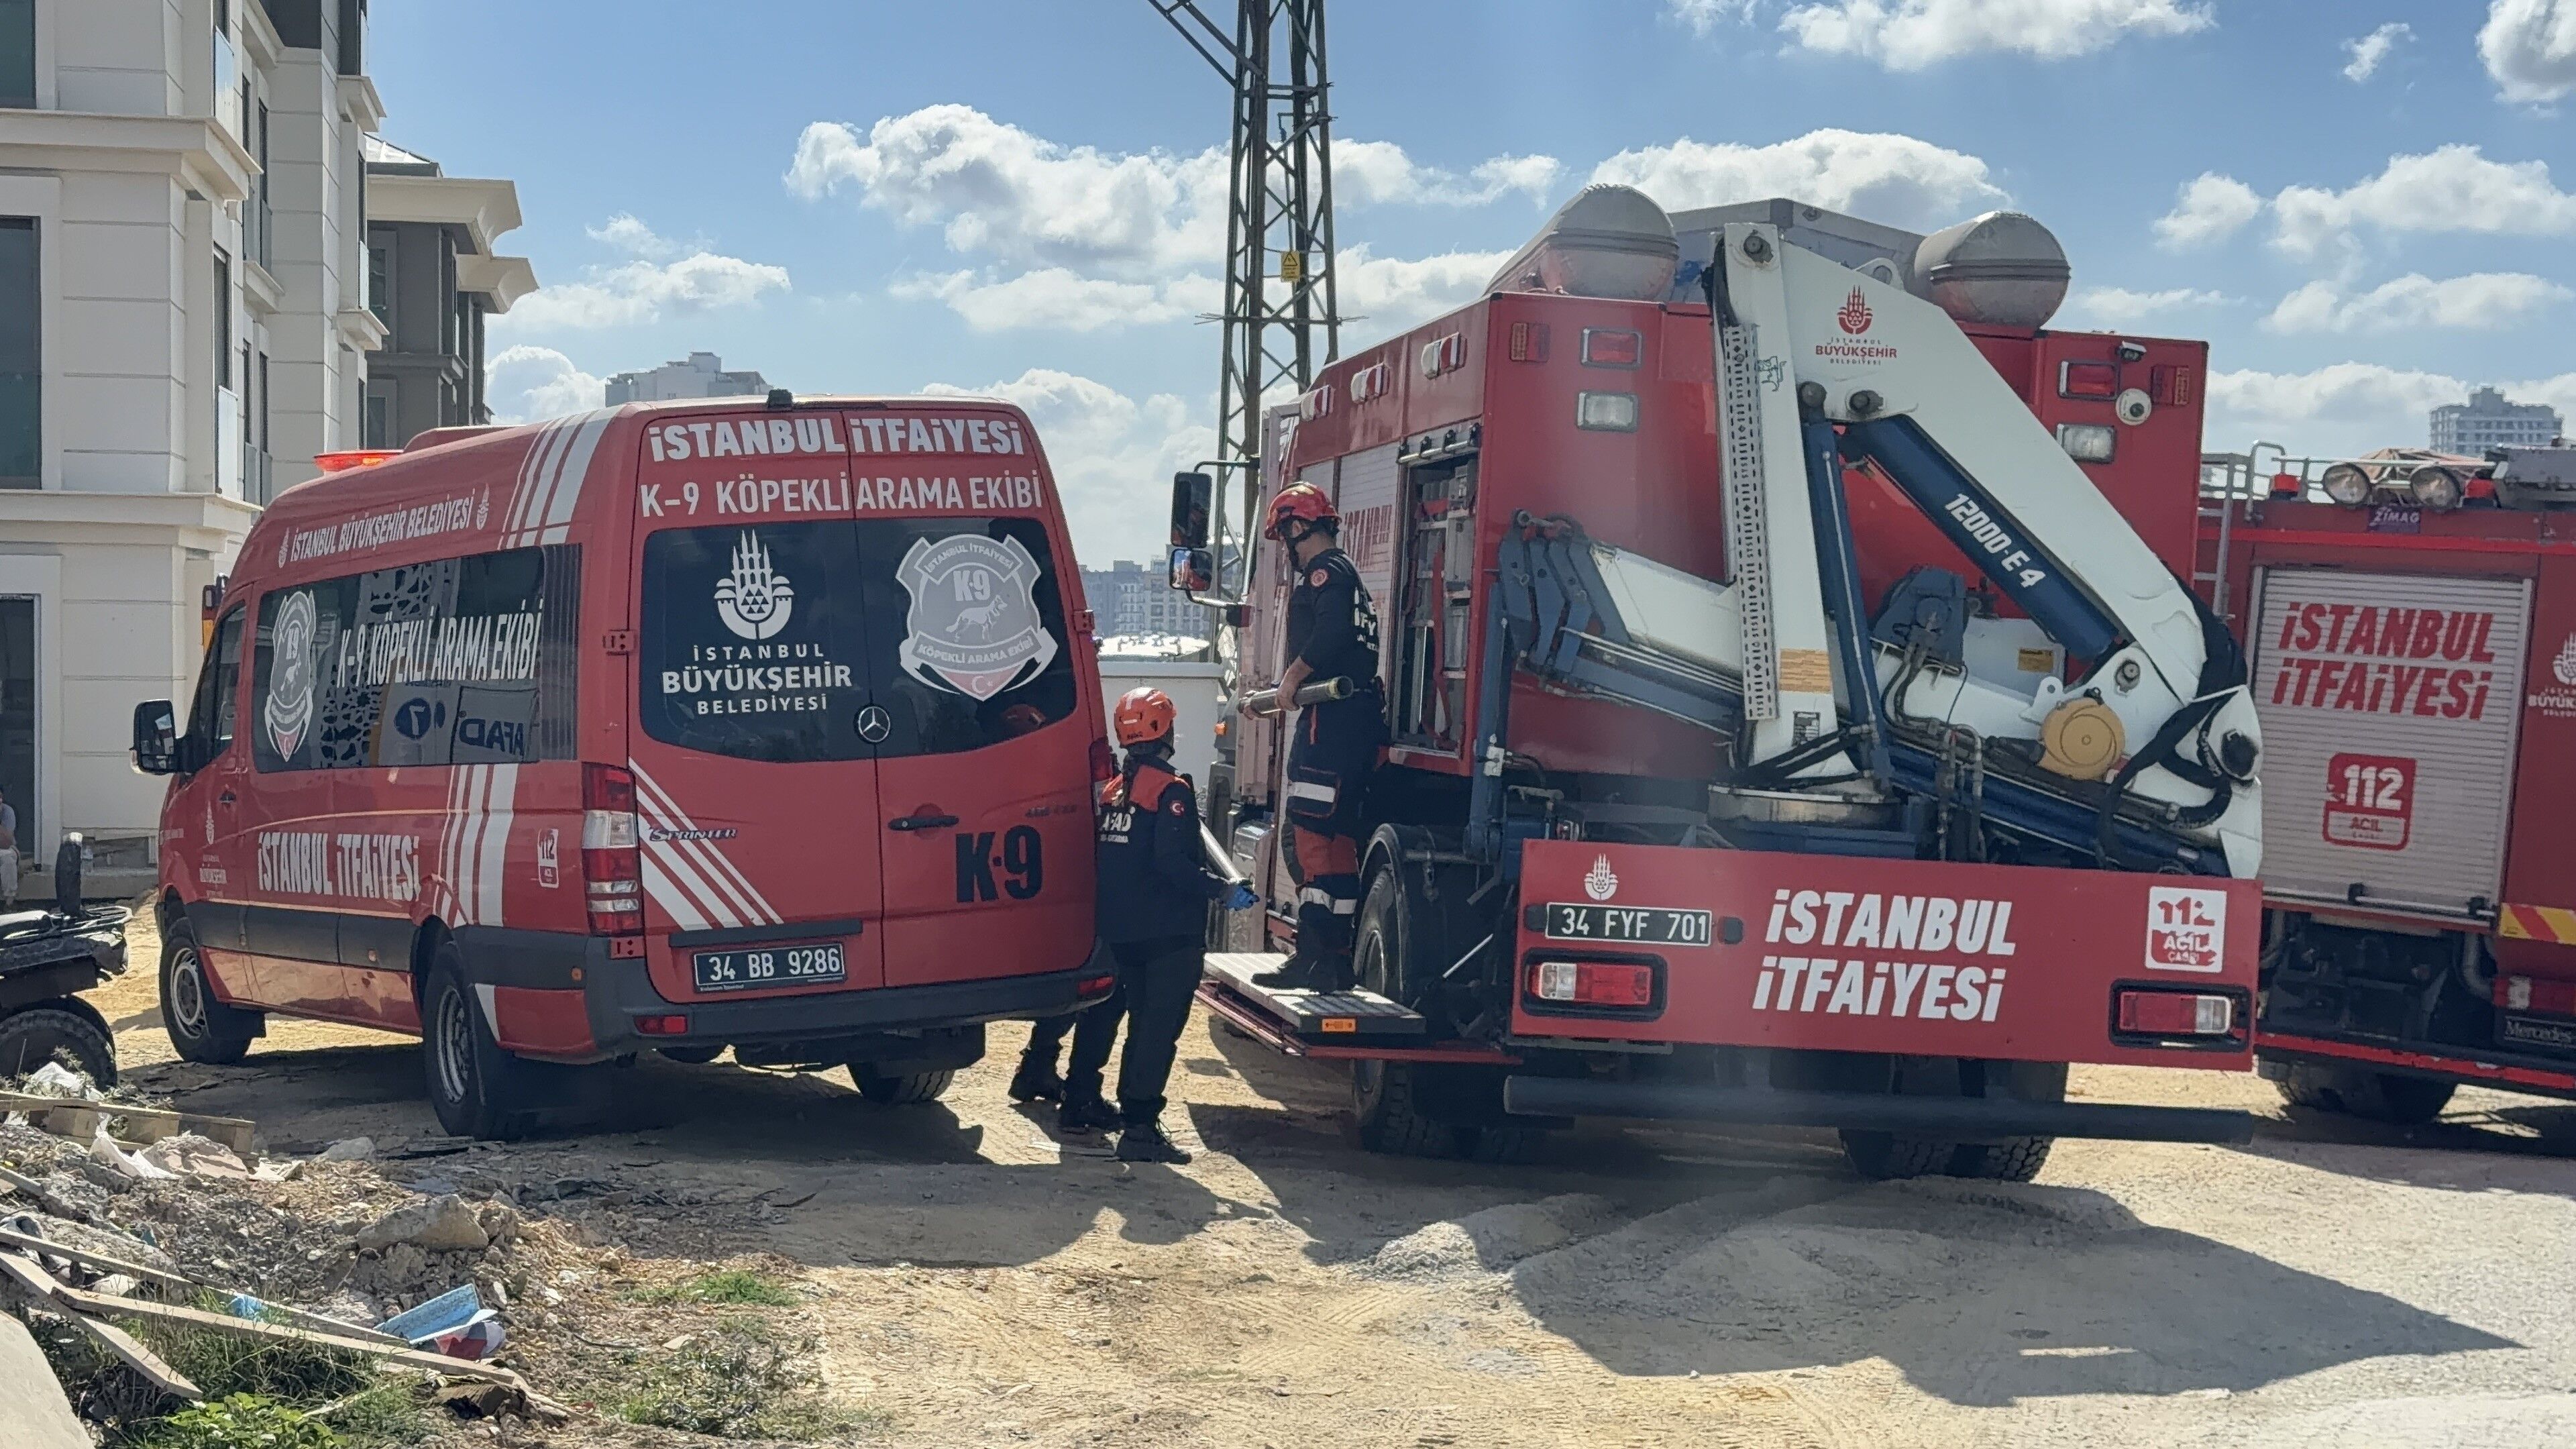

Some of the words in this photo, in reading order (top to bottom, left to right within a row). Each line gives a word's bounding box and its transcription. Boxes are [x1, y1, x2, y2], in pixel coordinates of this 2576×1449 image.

[641, 482, 700, 517] K-9
[716, 472, 850, 514] KÖPEKLİ
[856, 477, 965, 511] ARAMA
[971, 469, 1042, 509] EKİBİ
[368, 606, 435, 686] KÖPEKLİ
[431, 615, 491, 680] ARAMA
[490, 598, 543, 680] EKİBİ
[694, 644, 824, 662] İSTANBUL
[662, 661, 853, 694] BÜYÜKŞEHİR
[698, 694, 827, 715] BELEDİYESİ
[2344, 764, 2404, 811] 112
[1561, 908, 1590, 934] 34
[1604, 910, 1649, 938] FYF
[1668, 912, 1707, 941] 701
[708, 956, 736, 981] 34
[748, 953, 775, 978] BB
[788, 948, 841, 975] 9286
